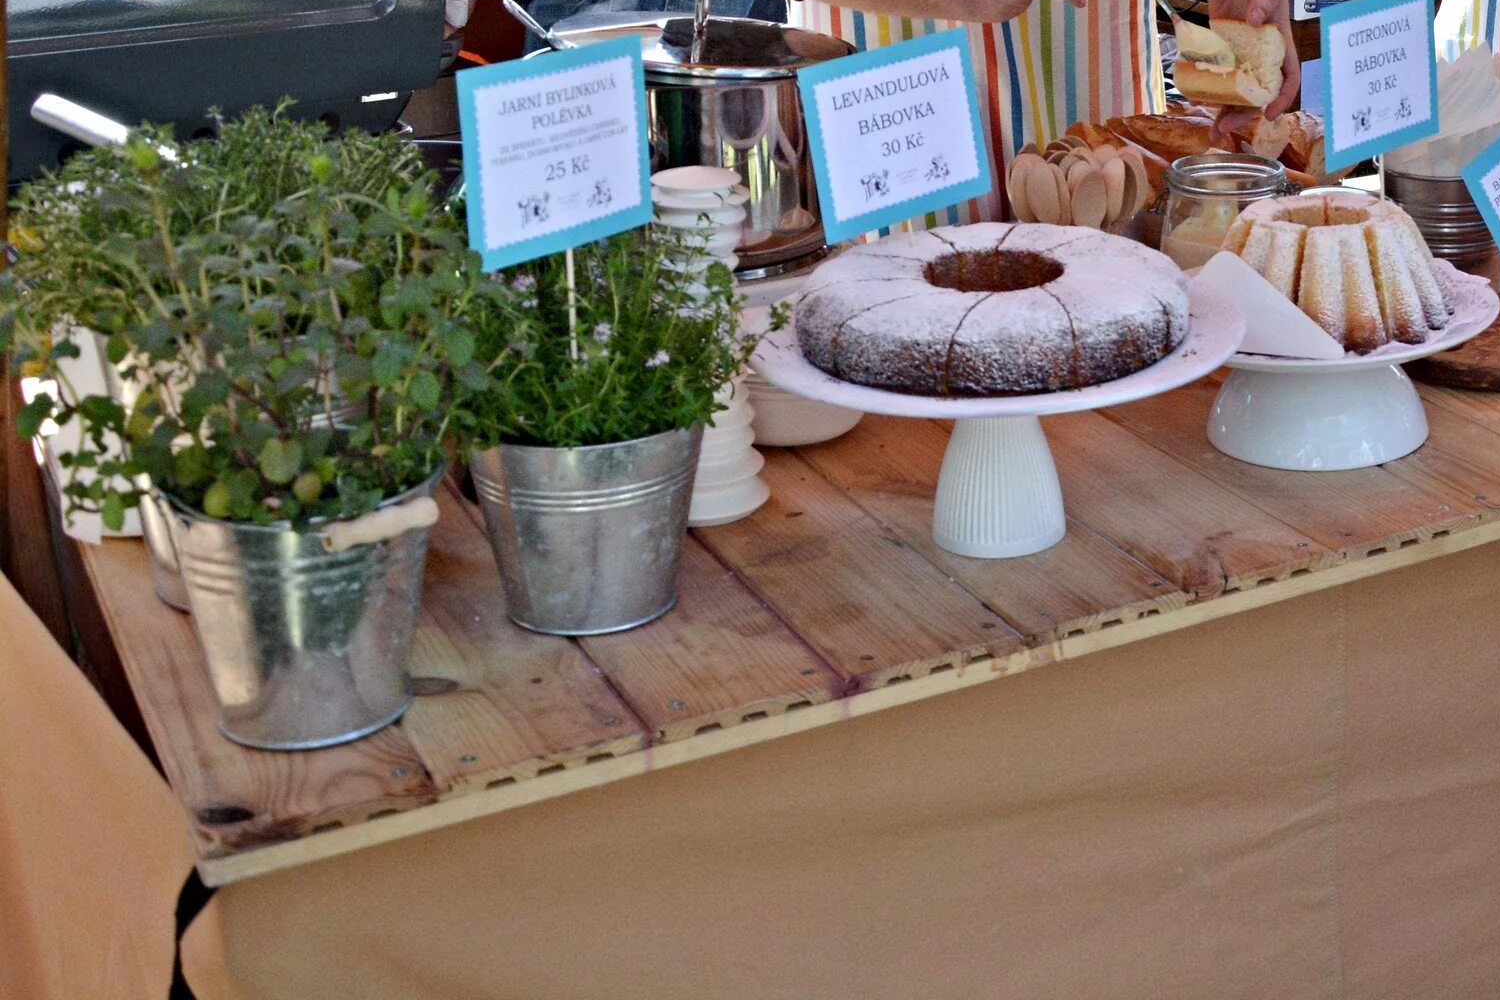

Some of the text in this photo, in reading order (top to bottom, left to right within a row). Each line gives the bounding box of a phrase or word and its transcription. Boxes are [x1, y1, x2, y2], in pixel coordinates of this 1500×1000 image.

[1347, 15, 1411, 48] CITRONOVÁ
[1355, 47, 1407, 75] BÁBOVKA
[498, 73, 617, 116] JARNÍ BYLINKOVÁ
[831, 63, 950, 111] LEVANDULOVÁ
[1368, 74, 1398, 96] 30 Kč
[858, 101, 935, 136] BÁBOVKA
[881, 131, 924, 158] 30 Kč
[544, 154, 591, 182] 25 Kč
